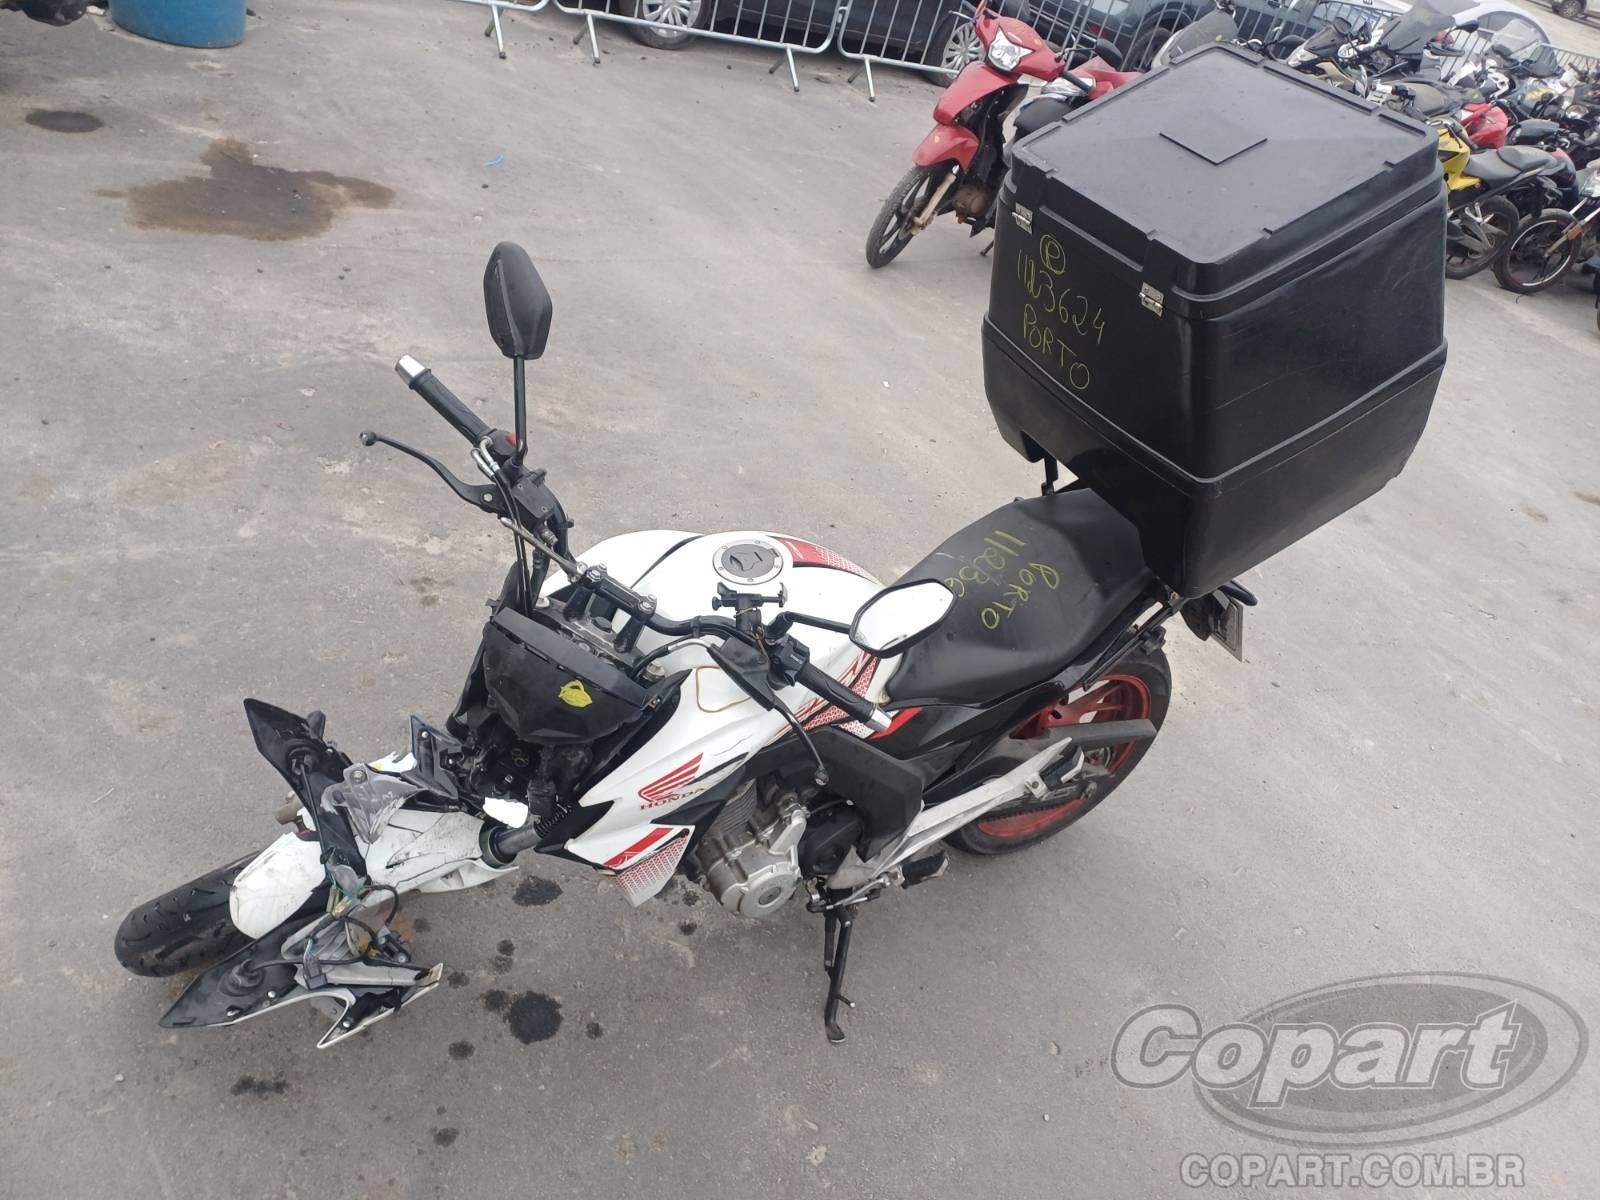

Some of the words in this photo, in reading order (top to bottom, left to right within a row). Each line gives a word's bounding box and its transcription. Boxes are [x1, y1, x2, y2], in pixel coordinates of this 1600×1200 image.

[1023, 303, 1090, 389] PORTO
[981, 562, 1060, 630] PORTO
[640, 788, 704, 810] HONDA
